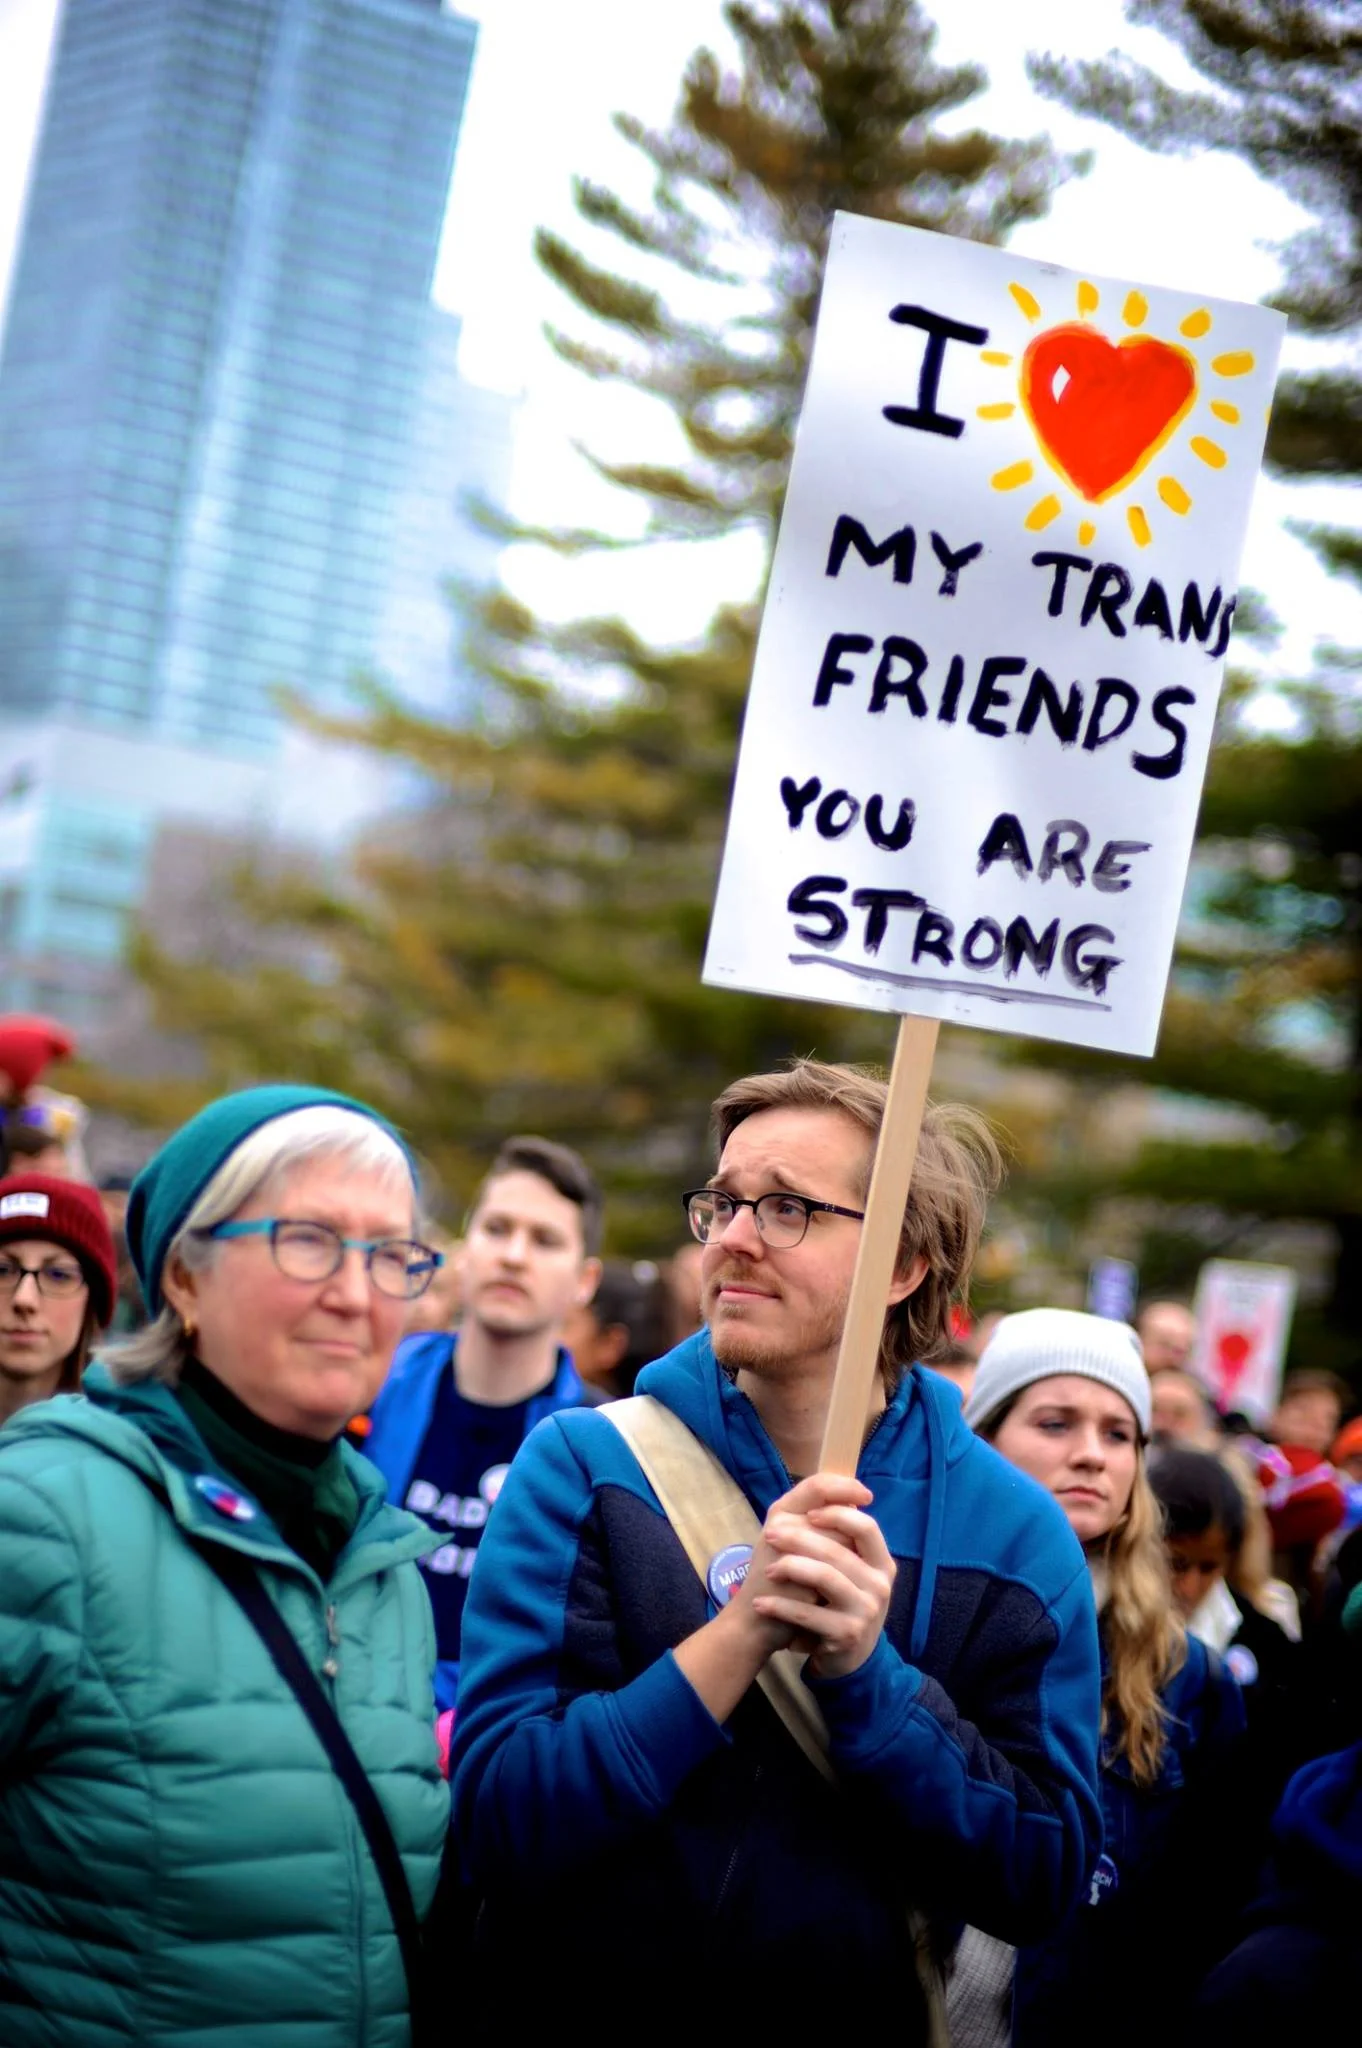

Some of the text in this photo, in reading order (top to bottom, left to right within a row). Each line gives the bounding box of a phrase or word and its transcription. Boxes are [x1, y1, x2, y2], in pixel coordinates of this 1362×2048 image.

[883, 304, 989, 439] I
[826, 514, 1237, 658] MY TRANS
[813, 634, 1196, 780] FRIENDS
[780, 777, 1153, 893] YOU ARE
[787, 876, 1122, 996] STRONG
